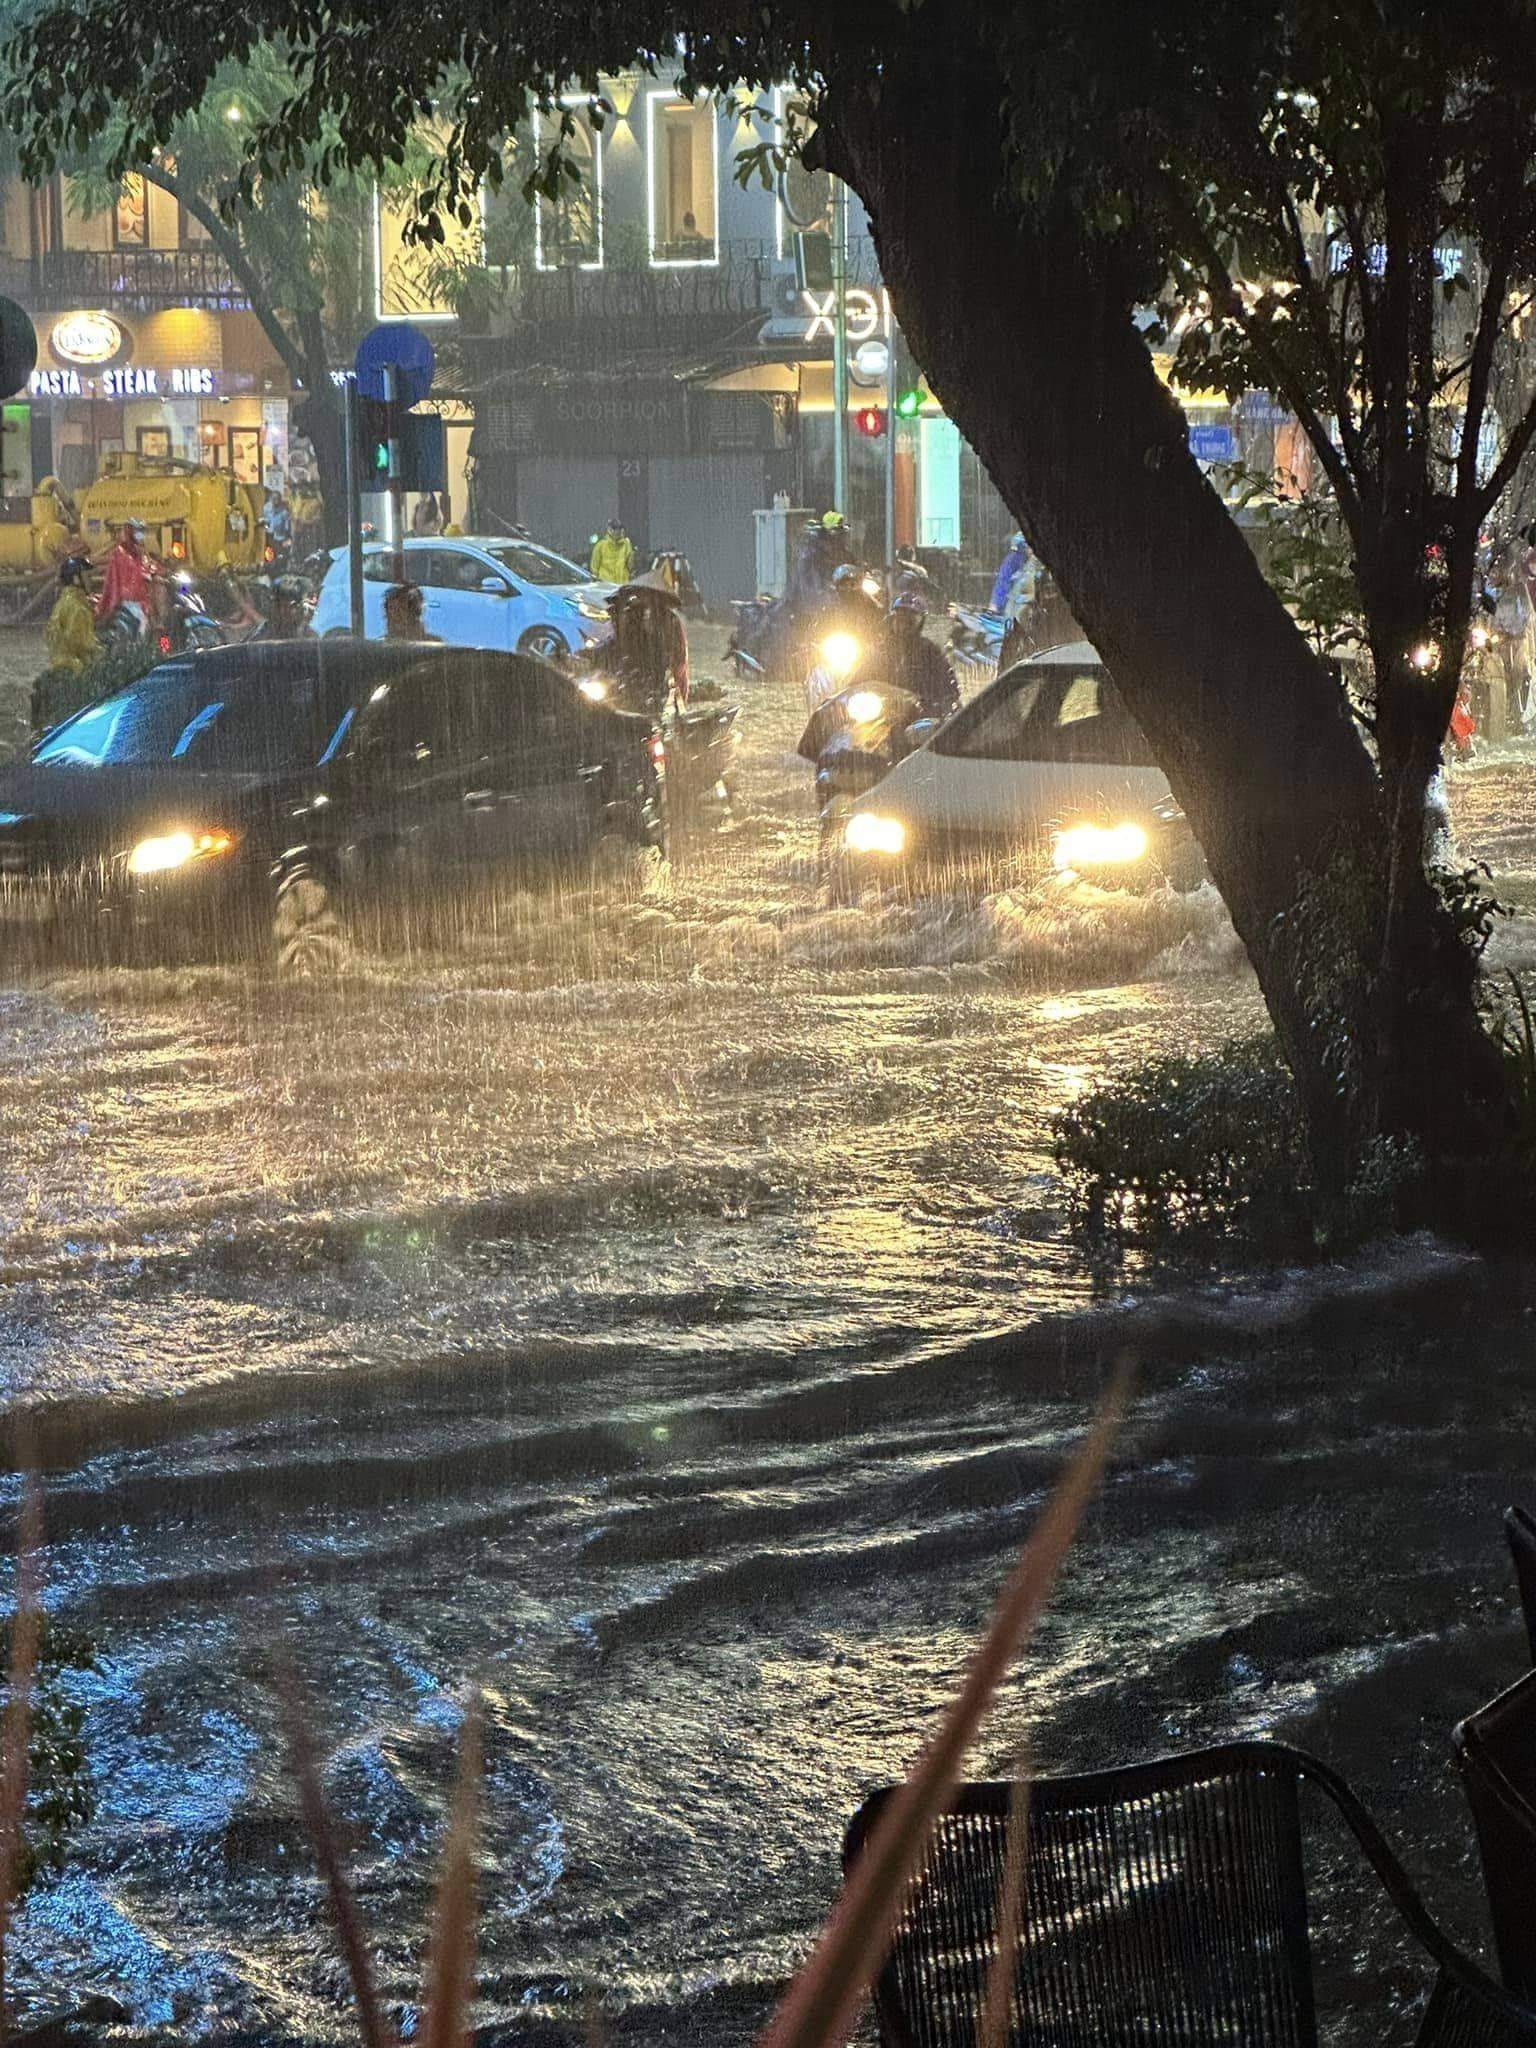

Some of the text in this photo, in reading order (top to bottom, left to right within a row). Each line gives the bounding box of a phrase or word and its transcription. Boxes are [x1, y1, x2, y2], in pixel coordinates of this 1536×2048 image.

[30, 366, 217, 395] PASTA STEAK RIBS
[621, 459, 641, 478] 23
